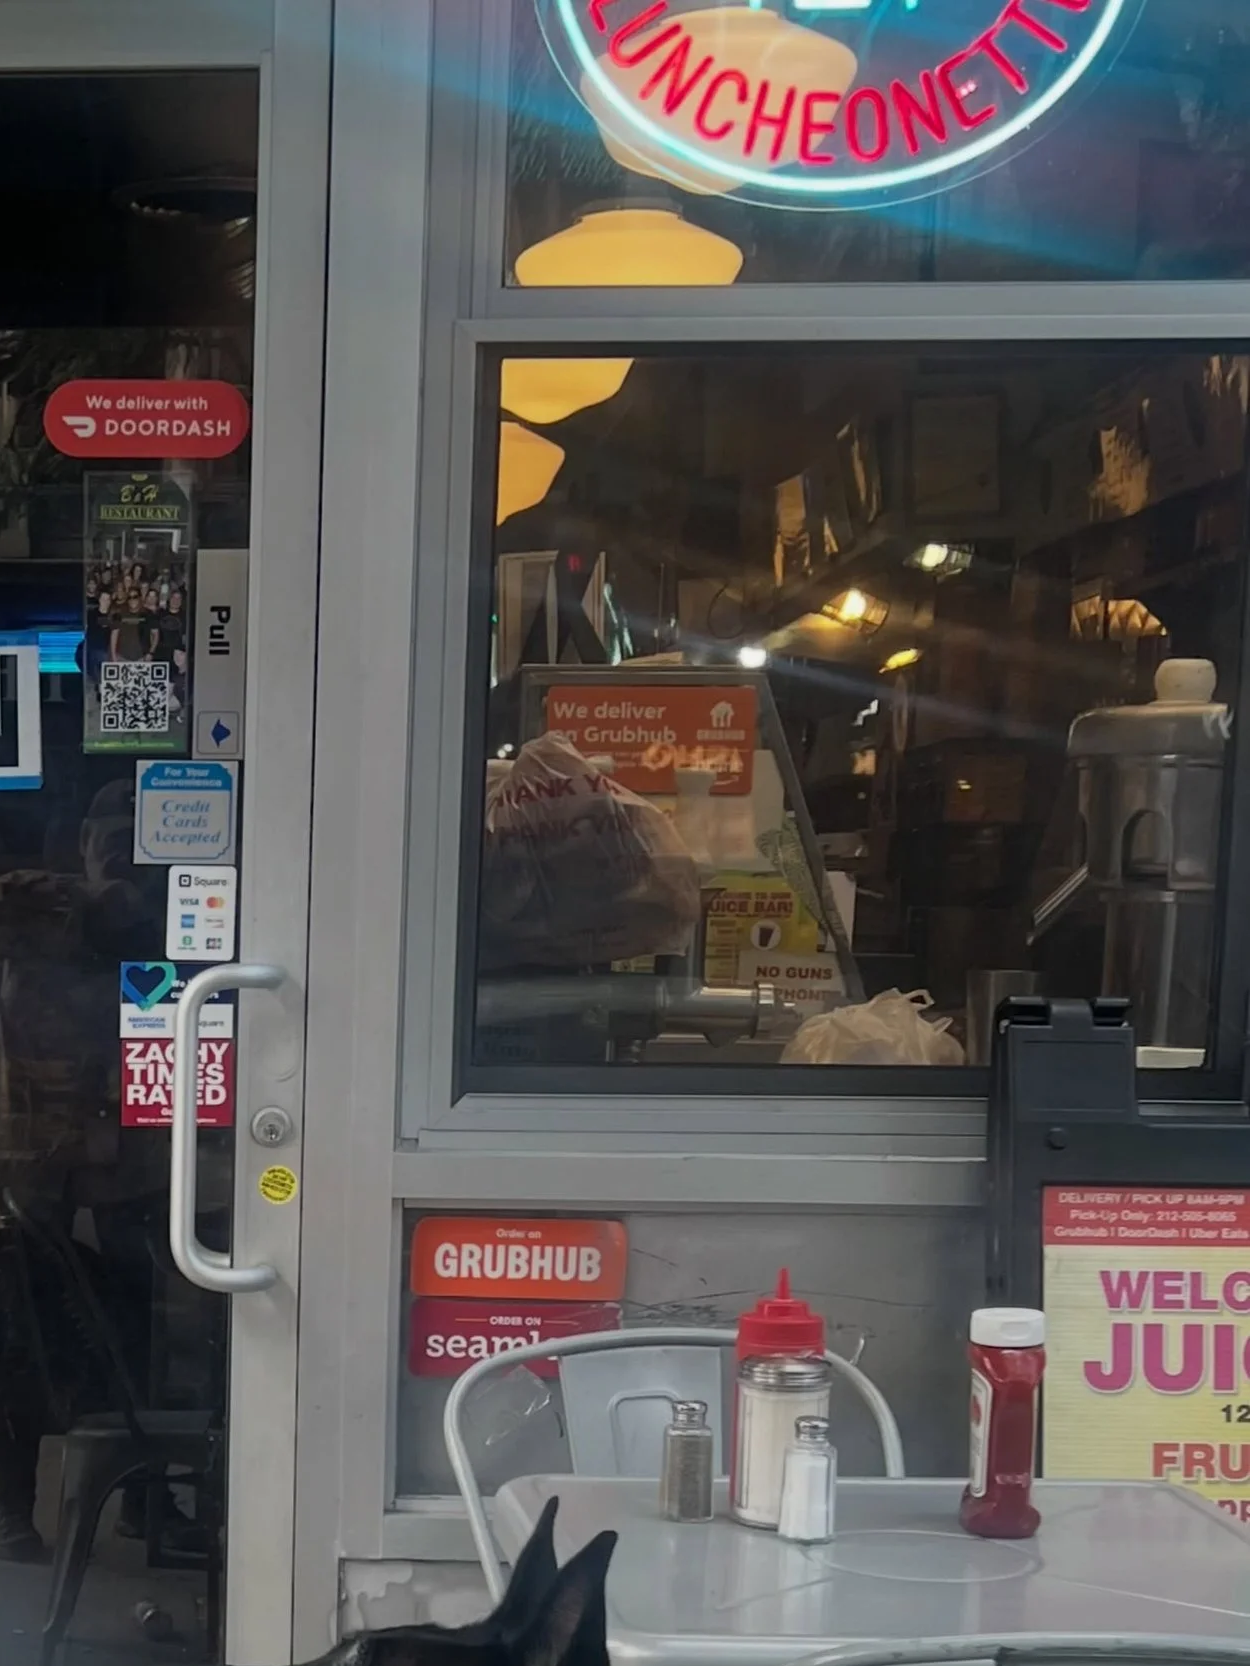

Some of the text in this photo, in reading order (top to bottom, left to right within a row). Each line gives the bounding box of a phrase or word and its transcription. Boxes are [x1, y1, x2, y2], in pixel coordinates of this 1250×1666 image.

[590, 0, 1092, 166] LUNCHEONETT
[86, 395, 209, 411] We deliver with
[104, 419, 231, 437] DOORDASH
[100, 504, 181, 521] RESTAURANT
[209, 605, 231, 656] Pull
[554, 702, 667, 719] We deliver
[584, 726, 677, 743] Grubhub
[164, 767, 211, 778] For Your
[150, 777, 223, 788] Convenience
[161, 799, 211, 814] Credit
[162, 815, 210, 829] Cards
[152, 830, 222, 846] Accepted
[709, 900, 748, 914] UICE
[755, 964, 833, 980] NO GUNS
[1058, 1191, 1123, 1204] DELIVERY
[1132, 1193, 1163, 1205] PICK
[1166, 1193, 1184, 1205] UP
[1069, 1209, 1117, 1223] Pick-Up
[496, 1228, 543, 1240] Order on
[1053, 1226, 1108, 1238] Grubhub
[1117, 1226, 1180, 1239] DoorDash
[1188, 1227, 1219, 1239] Uber
[433, 1242, 602, 1282] GRUBHUB
[489, 1316, 542, 1327] ORDER ON
[1082, 1322, 1250, 1395] JUI
